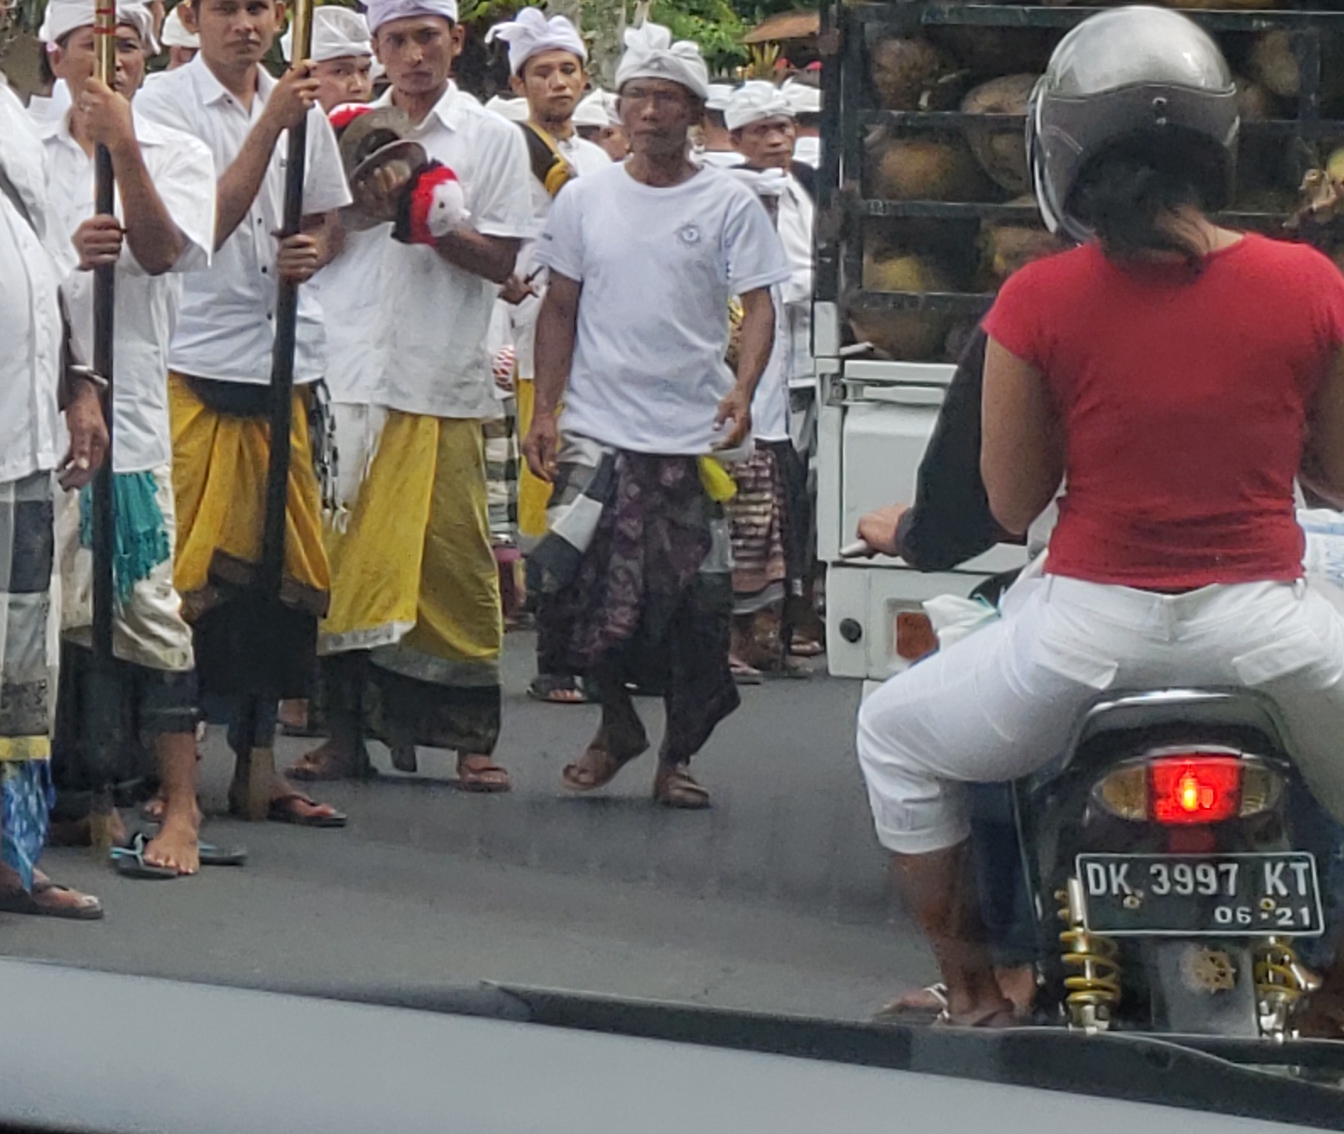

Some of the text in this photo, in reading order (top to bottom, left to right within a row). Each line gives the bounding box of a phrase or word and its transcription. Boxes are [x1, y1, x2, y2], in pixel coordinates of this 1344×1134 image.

[1086, 862, 1309, 896] DK 3997 KT
